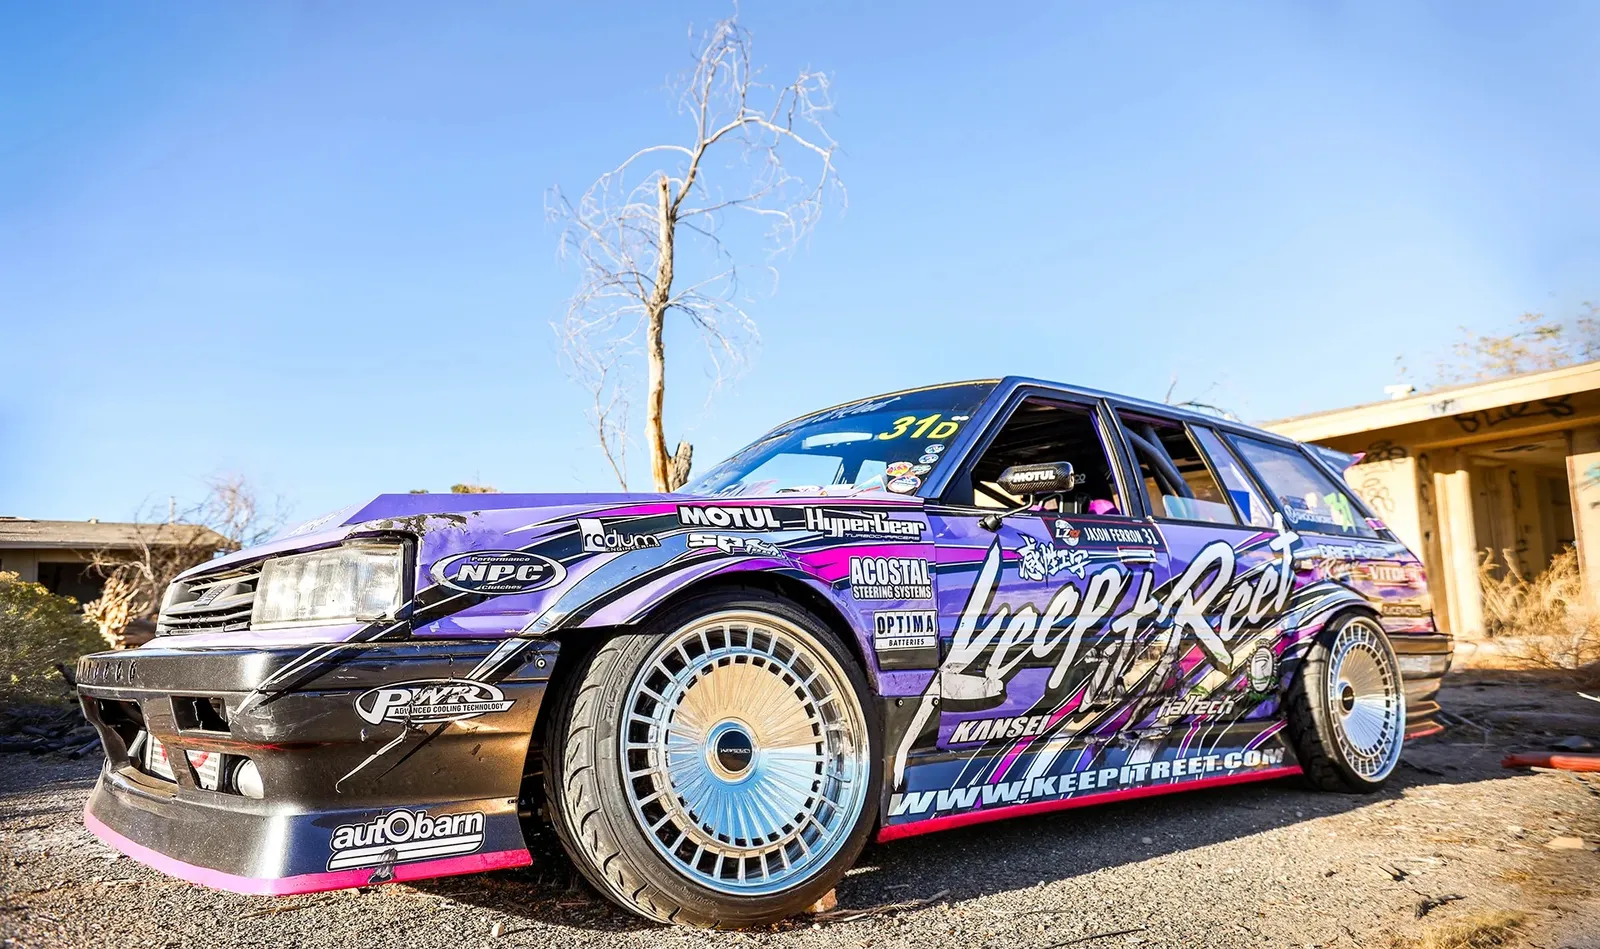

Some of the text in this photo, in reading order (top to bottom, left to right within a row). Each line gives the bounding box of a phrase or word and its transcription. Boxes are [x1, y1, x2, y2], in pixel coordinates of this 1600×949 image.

[1013, 470, 1056, 483] MOTUL
[680, 507, 780, 528] MOTUL
[805, 508, 925, 538] HyperGear
[1084, 527, 1111, 541] JASON
[1110, 528, 1143, 543] FERRON
[1141, 528, 1159, 545] 31
[457, 564, 544, 581] NPC
[851, 558, 930, 585] ACOSTAL
[853, 585, 932, 599] STEERING SYSTEMS
[876, 615, 934, 634] OPTIMA
[888, 638, 925, 647] BATTERIES
[394, 701, 504, 715] ADVANCED COOLING TECHNOLOGY
[1156, 695, 1235, 718] Haltech
[949, 714, 1052, 744] KANSEI
[887, 748, 1285, 817] WWW.KEEPITREET.COM
